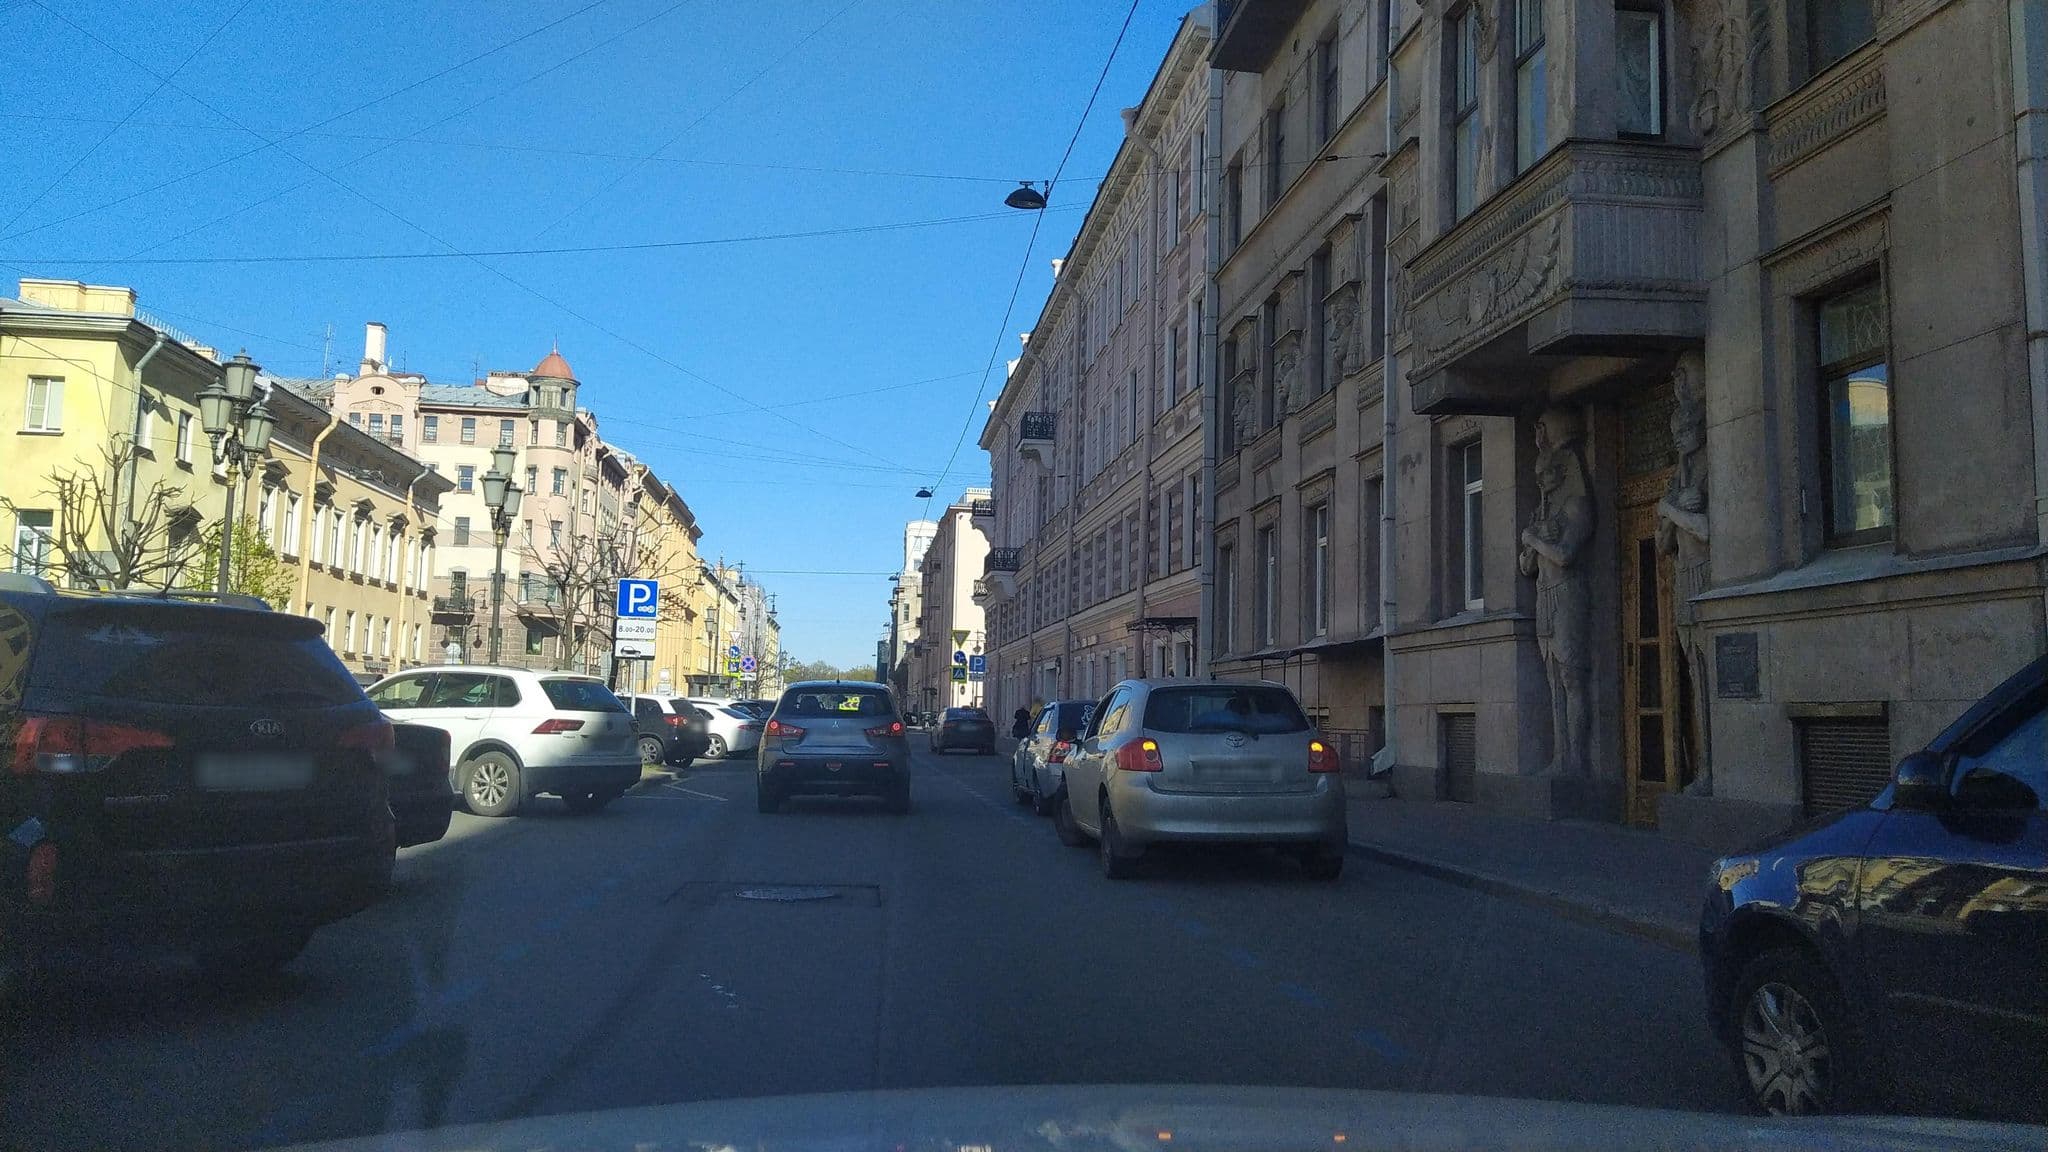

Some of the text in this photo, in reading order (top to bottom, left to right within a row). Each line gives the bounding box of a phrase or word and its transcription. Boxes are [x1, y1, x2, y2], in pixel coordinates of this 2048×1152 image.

[629, 583, 651, 614] P
[618, 625, 655, 634] 8.00-20.00
[973, 656, 984, 671] P
